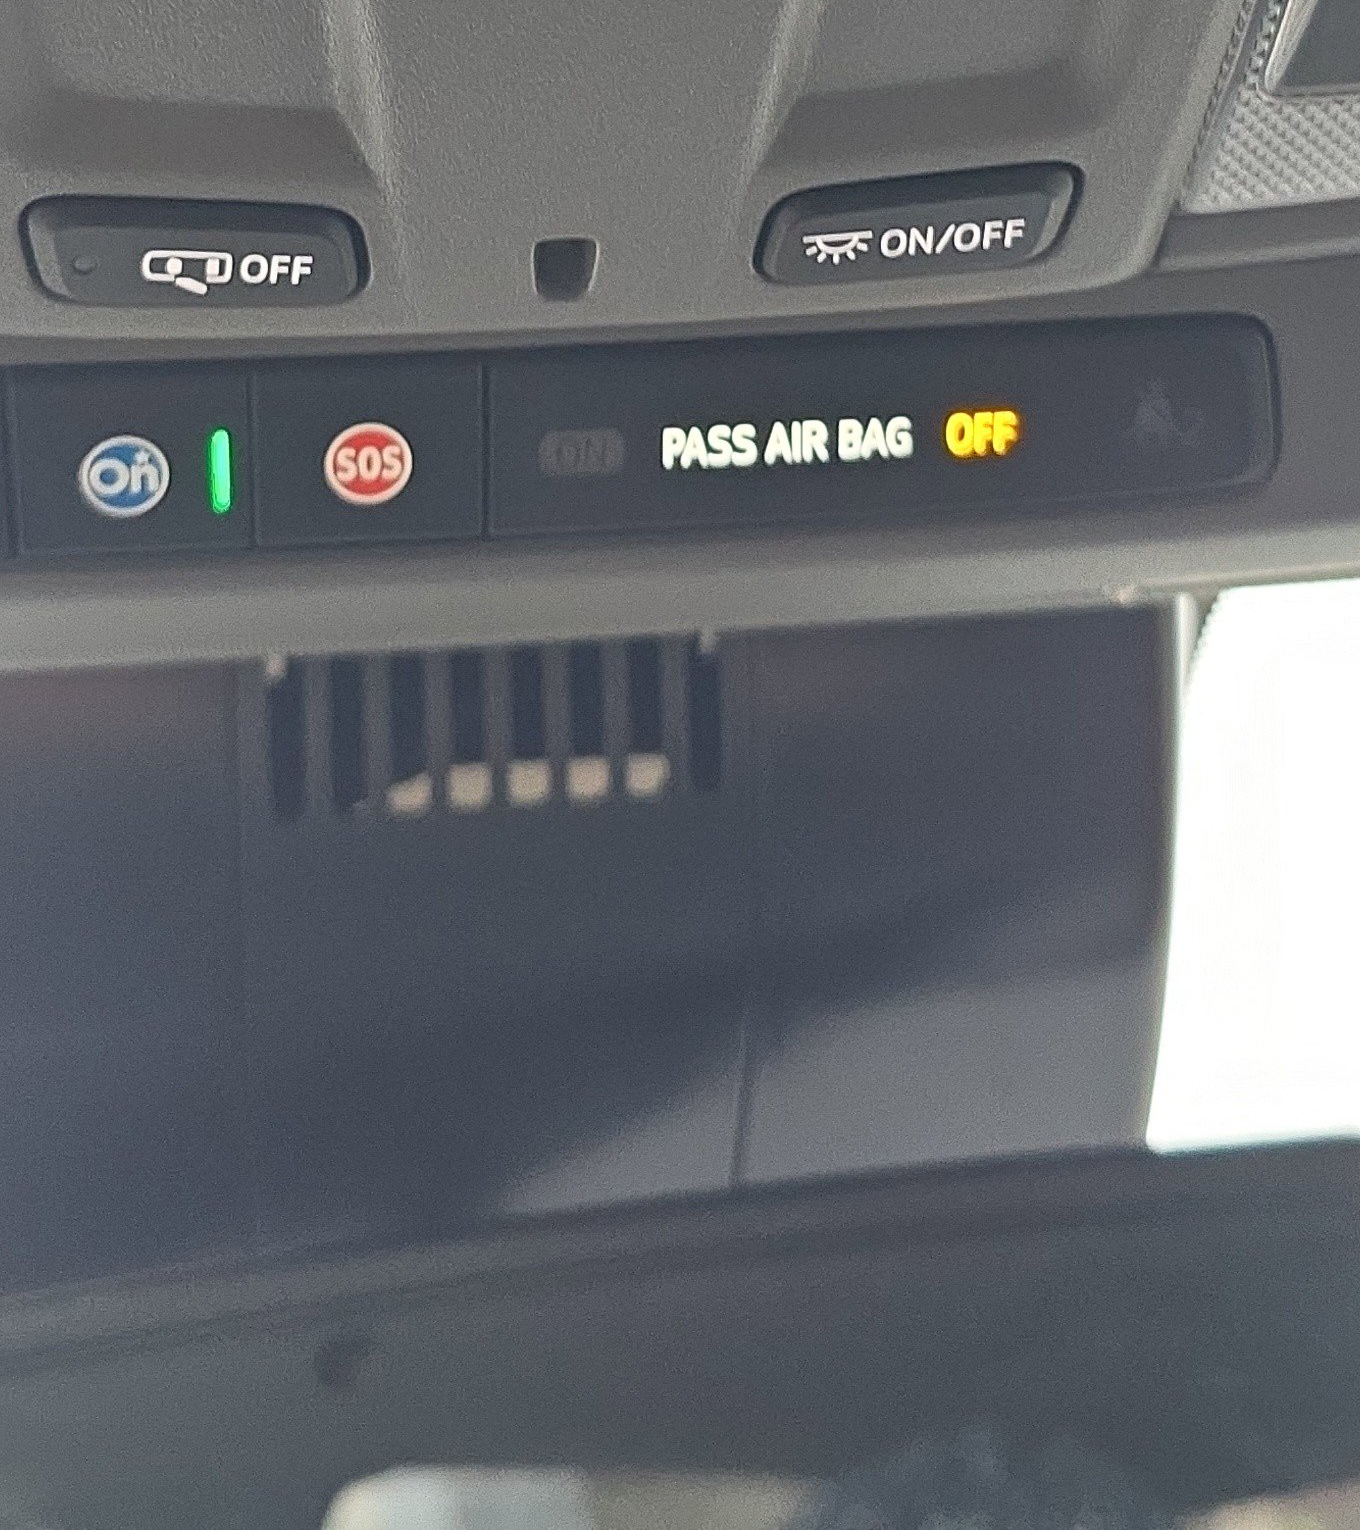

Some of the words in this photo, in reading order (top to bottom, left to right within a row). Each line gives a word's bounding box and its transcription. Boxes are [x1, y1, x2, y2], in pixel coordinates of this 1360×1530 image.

[879, 218, 1026, 259] ON/OFF
[240, 253, 314, 286] OFF
[661, 423, 759, 470] PASS
[763, 419, 830, 466] AIR
[837, 415, 915, 463] BAG
[944, 410, 1019, 458] OFF
[336, 444, 402, 482] SOS
